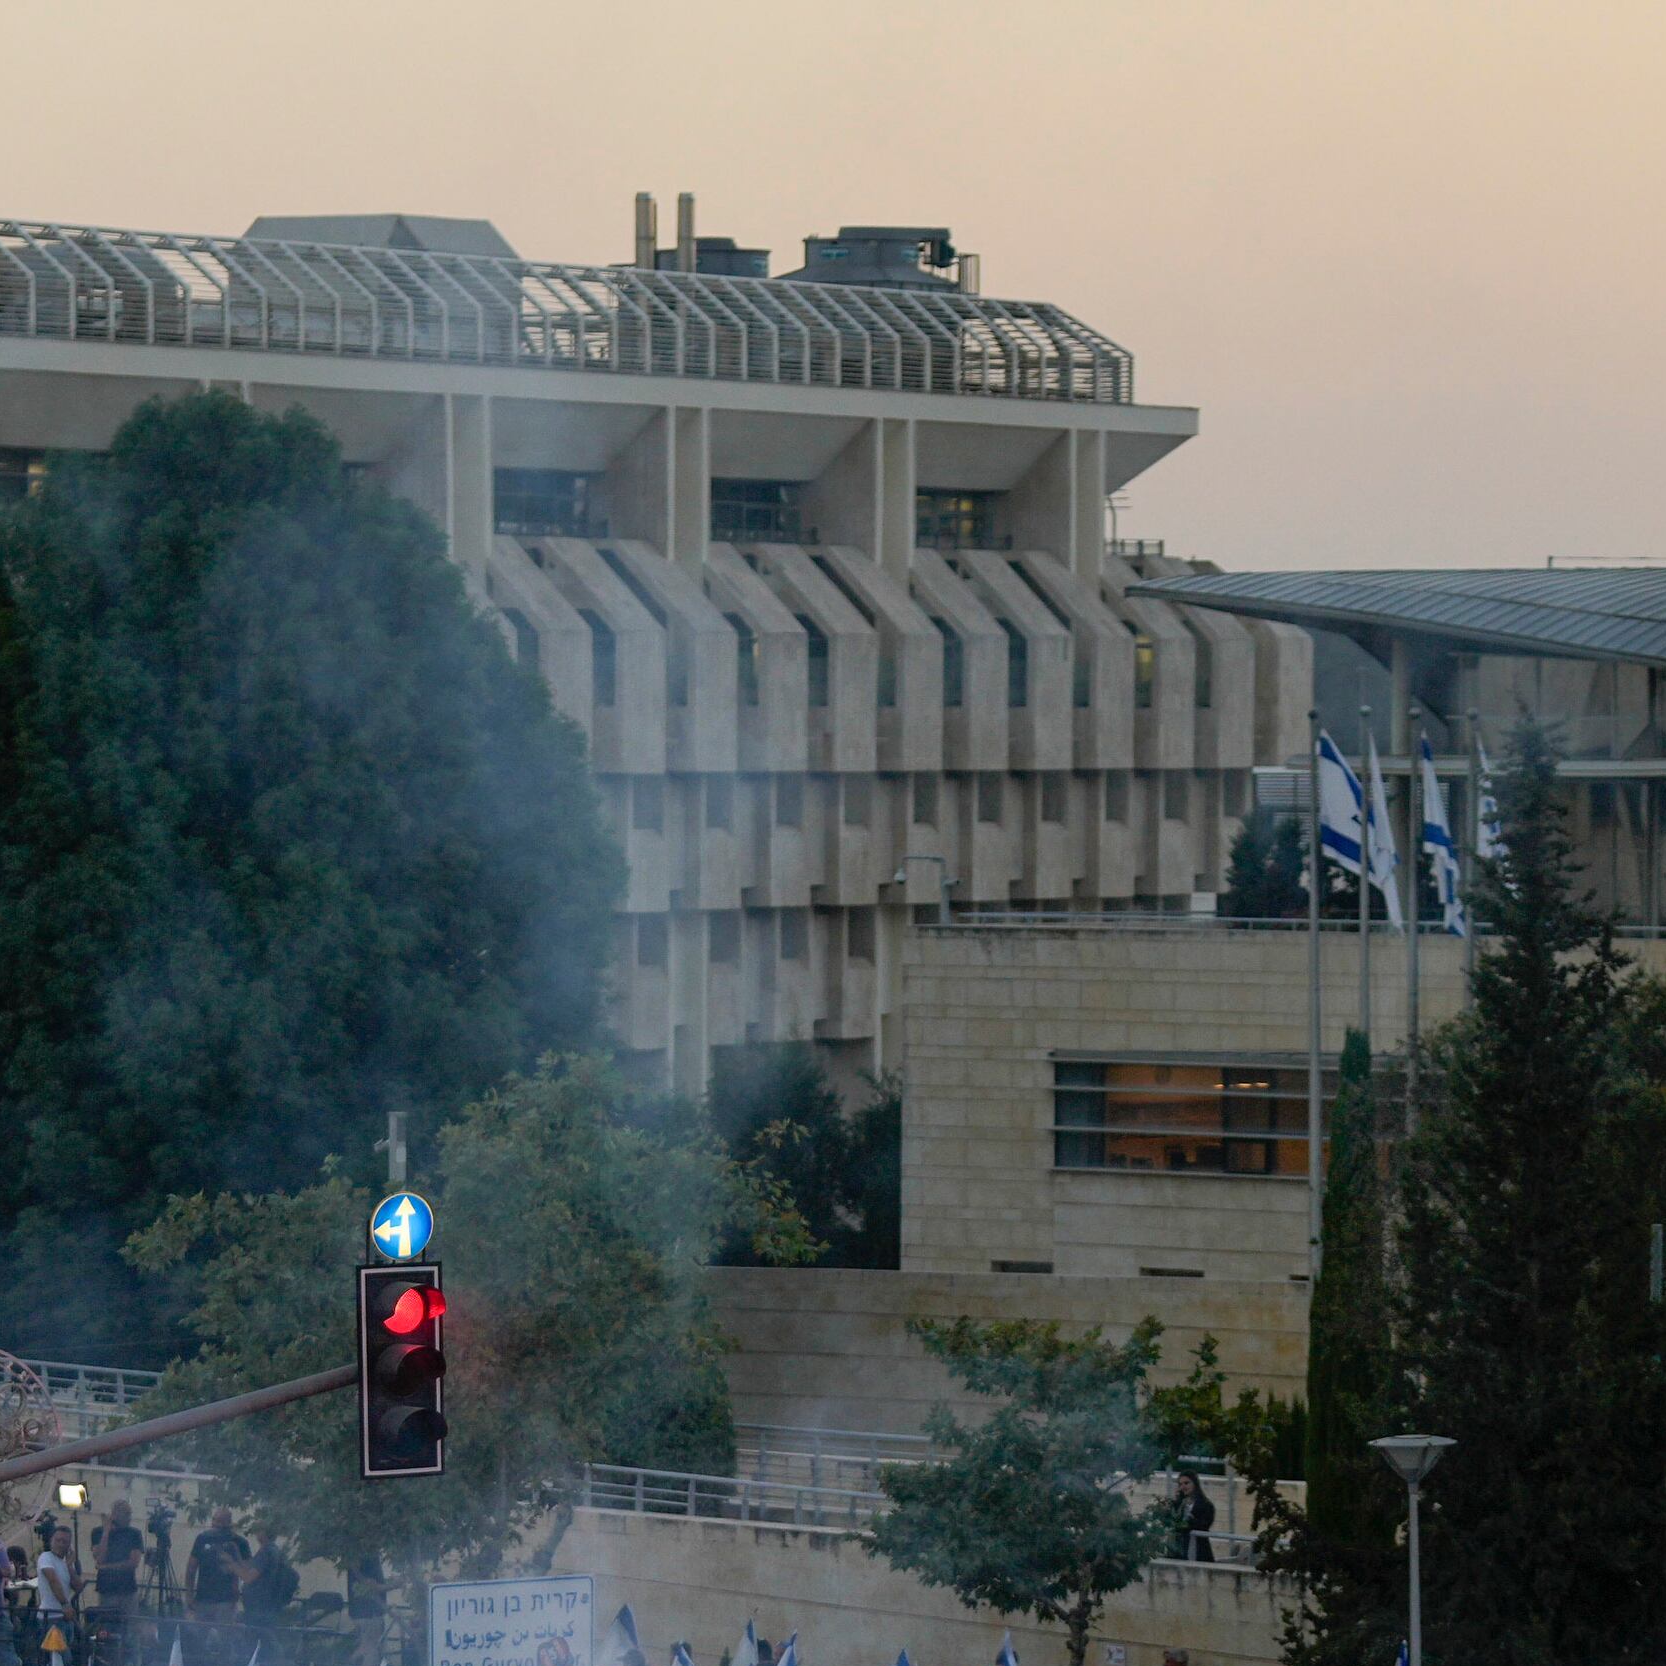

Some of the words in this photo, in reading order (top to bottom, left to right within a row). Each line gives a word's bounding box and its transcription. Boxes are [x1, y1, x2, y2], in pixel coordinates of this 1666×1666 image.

[448, 1596, 495, 1621] גוריון
[503, 1596, 521, 1617] בן
[532, 1591, 578, 1614] קרית
